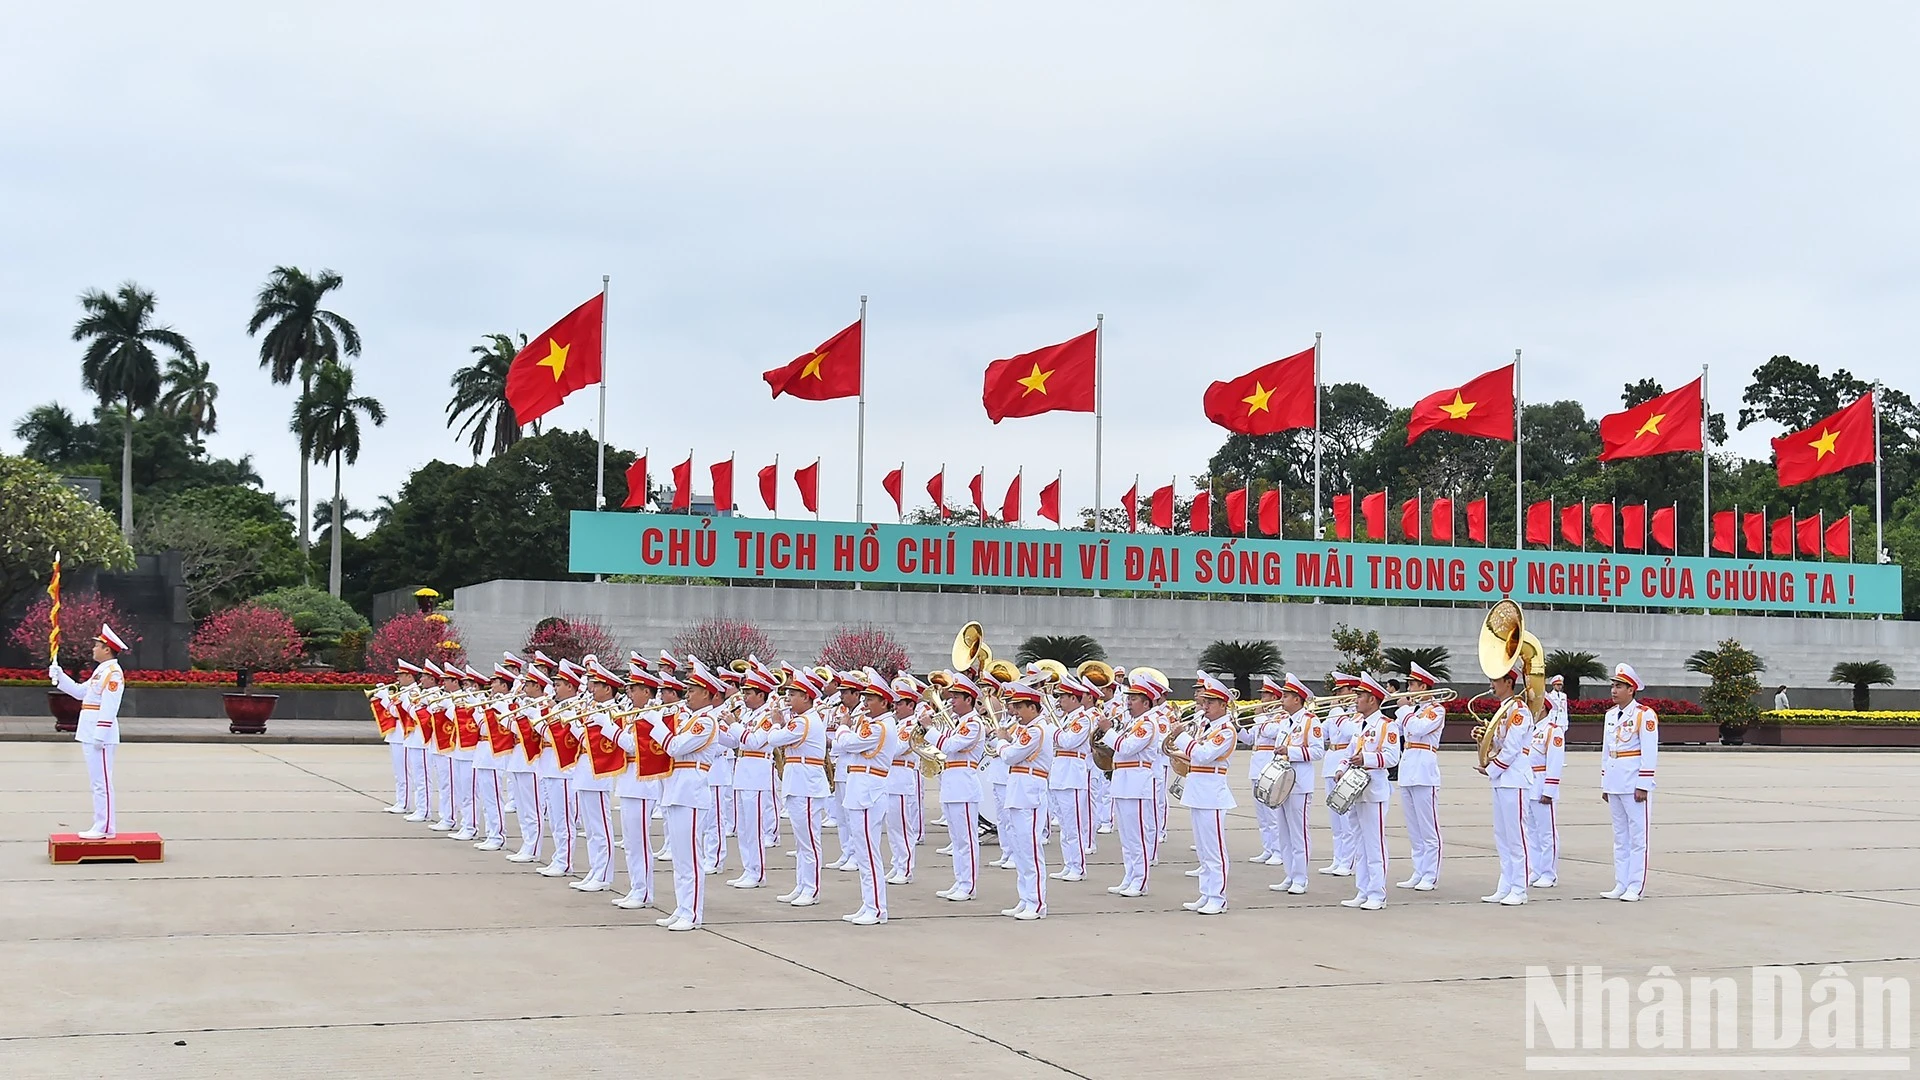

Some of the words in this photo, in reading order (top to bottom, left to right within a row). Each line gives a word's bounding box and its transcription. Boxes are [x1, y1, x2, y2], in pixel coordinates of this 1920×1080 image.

[641, 517, 717, 567] CHỦ
[734, 531, 817, 576] TỊCH
[834, 522, 880, 572] HỒ
[897, 530, 956, 575] CHÍ
[972, 540, 1062, 579] MINH
[1079, 538, 1110, 580] VĨ
[1124, 546, 1179, 588] ĐẠI
[1195, 538, 1281, 585] SỐNG
[1296, 547, 1353, 588] MÃI
[1367, 555, 1465, 592] TRONG
[1478, 557, 1519, 600] SỰ
[1528, 558, 1631, 602] NGHIỆP
[1641, 556, 1695, 599] CỦA
[1706, 563, 1795, 602] CHÚNG
[1805, 573, 1836, 604] TA
